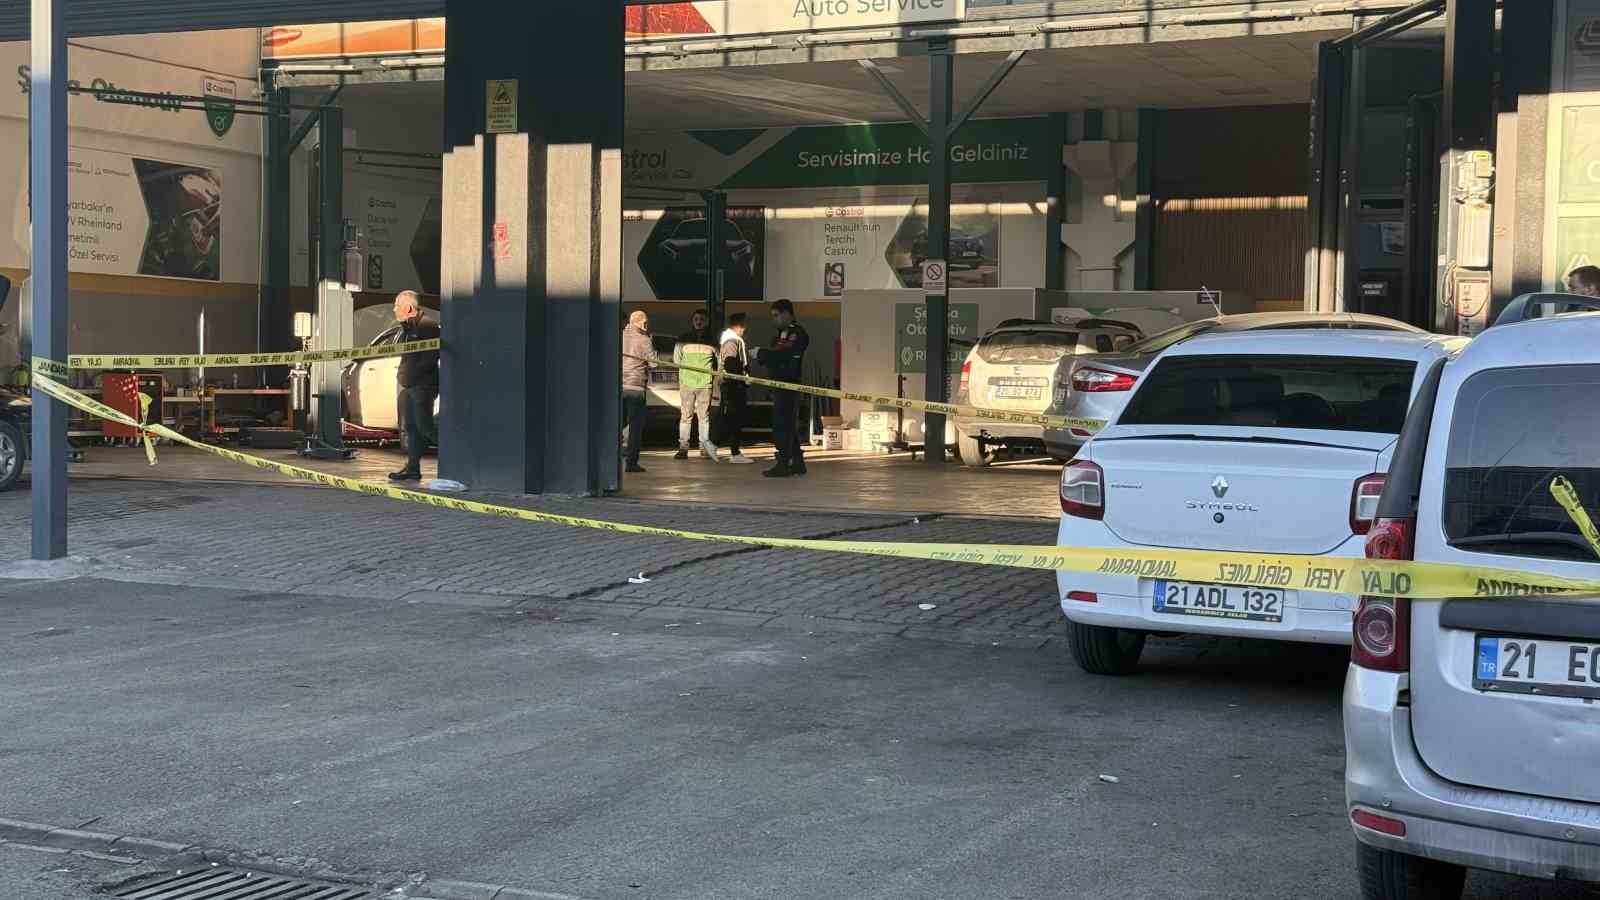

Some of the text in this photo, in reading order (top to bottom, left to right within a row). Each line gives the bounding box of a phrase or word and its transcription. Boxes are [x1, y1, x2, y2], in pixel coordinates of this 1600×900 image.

[793, 0, 849, 18] Auto
[797, 141, 1029, 168] Servisimize Ho Geldiniz
[1185, 500, 1259, 513] SYMBOL
[1166, 585, 1278, 613] 21 ADL 132
[1481, 662, 1496, 673] TR
[1502, 642, 1537, 679] 21
